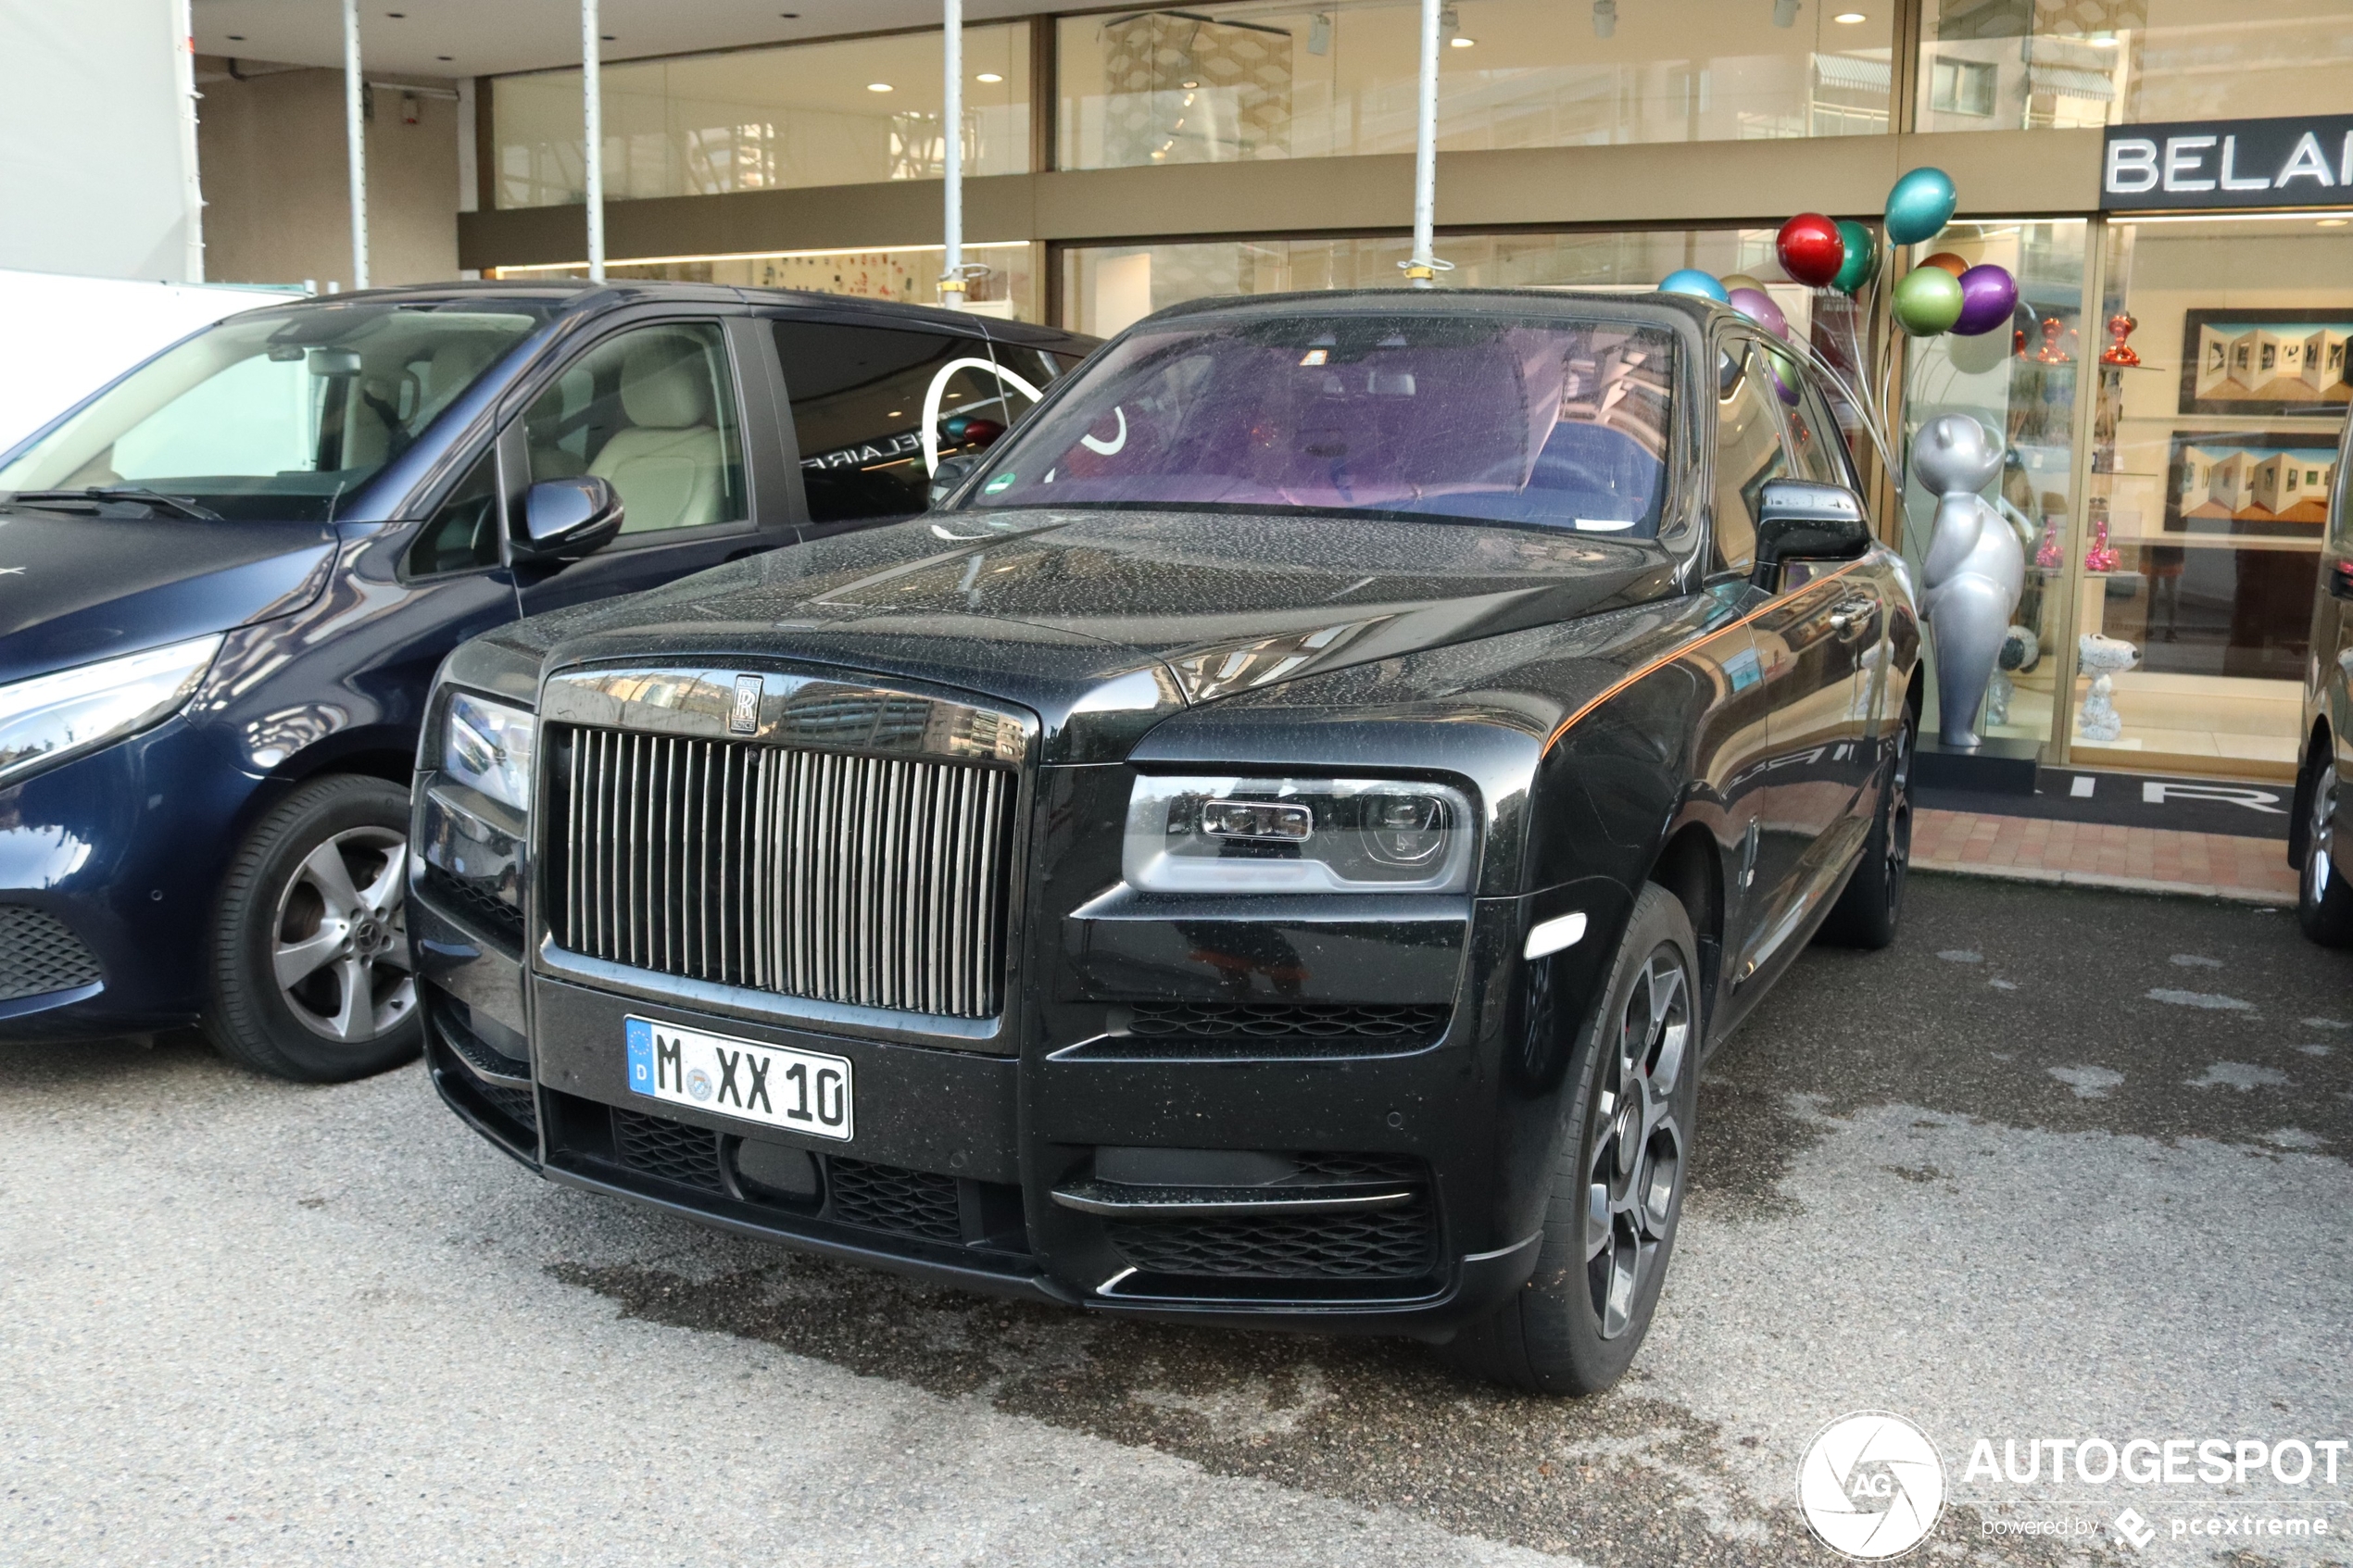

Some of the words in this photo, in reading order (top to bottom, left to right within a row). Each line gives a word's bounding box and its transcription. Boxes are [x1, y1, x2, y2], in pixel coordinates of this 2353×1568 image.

[733, 720, 754, 730] ROYCE
[636, 1063, 647, 1081] D
[656, 1034, 683, 1095] M
[715, 1047, 773, 1114] XX
[786, 1062, 844, 1127] 10
